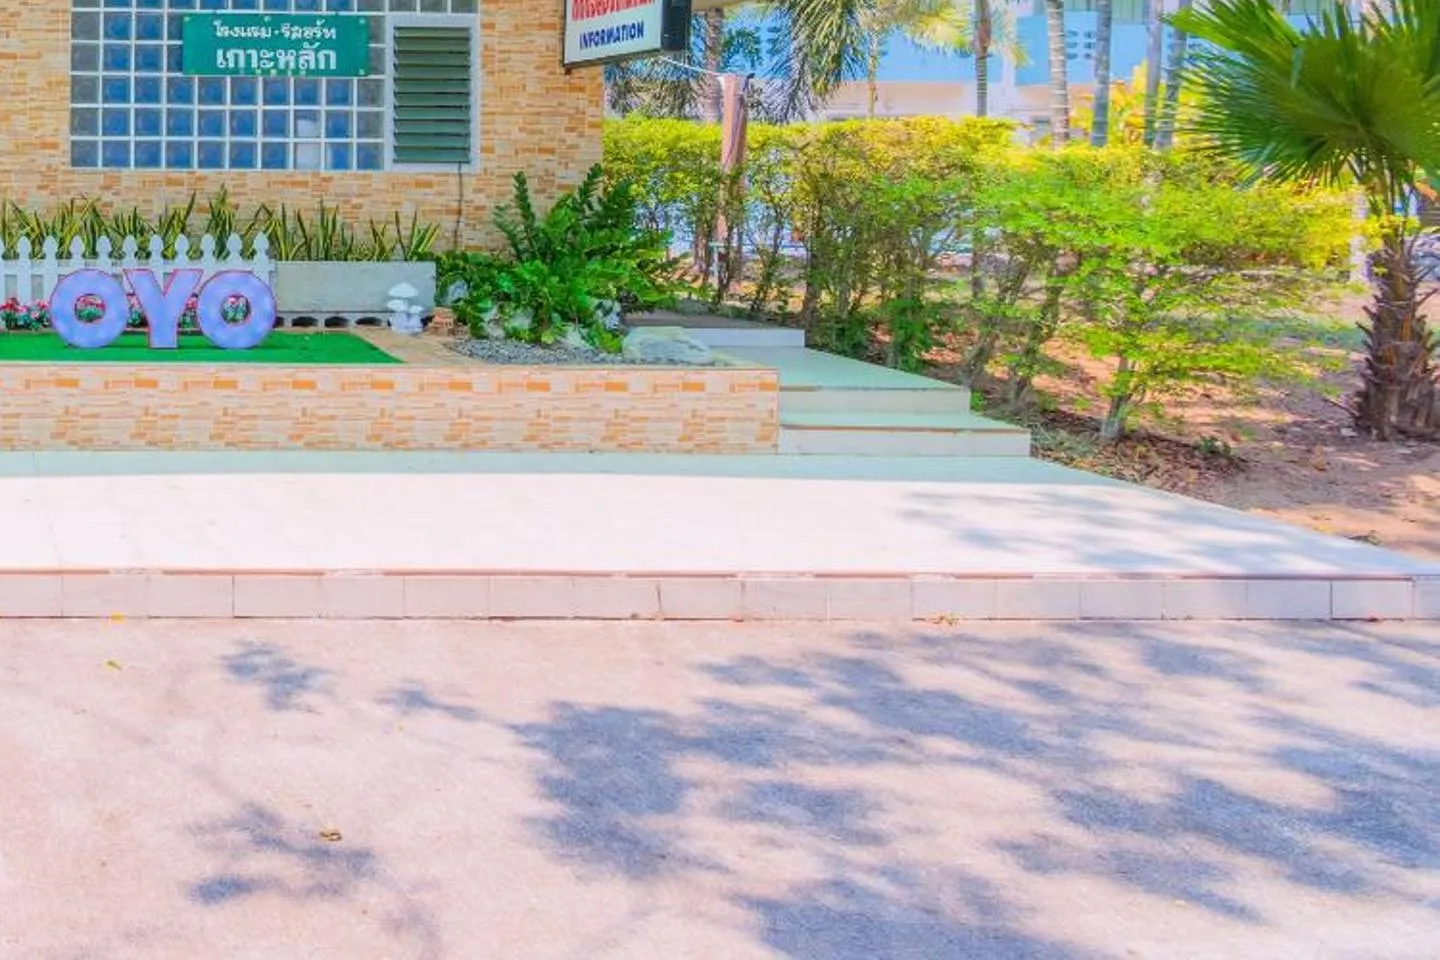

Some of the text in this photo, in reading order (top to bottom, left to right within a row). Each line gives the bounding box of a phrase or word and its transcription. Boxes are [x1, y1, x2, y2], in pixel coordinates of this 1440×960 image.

[580, 20, 644, 49] INFORMATION
[216, 42, 337, 70] เกาะหลัก
[50, 268, 277, 349] OYO
